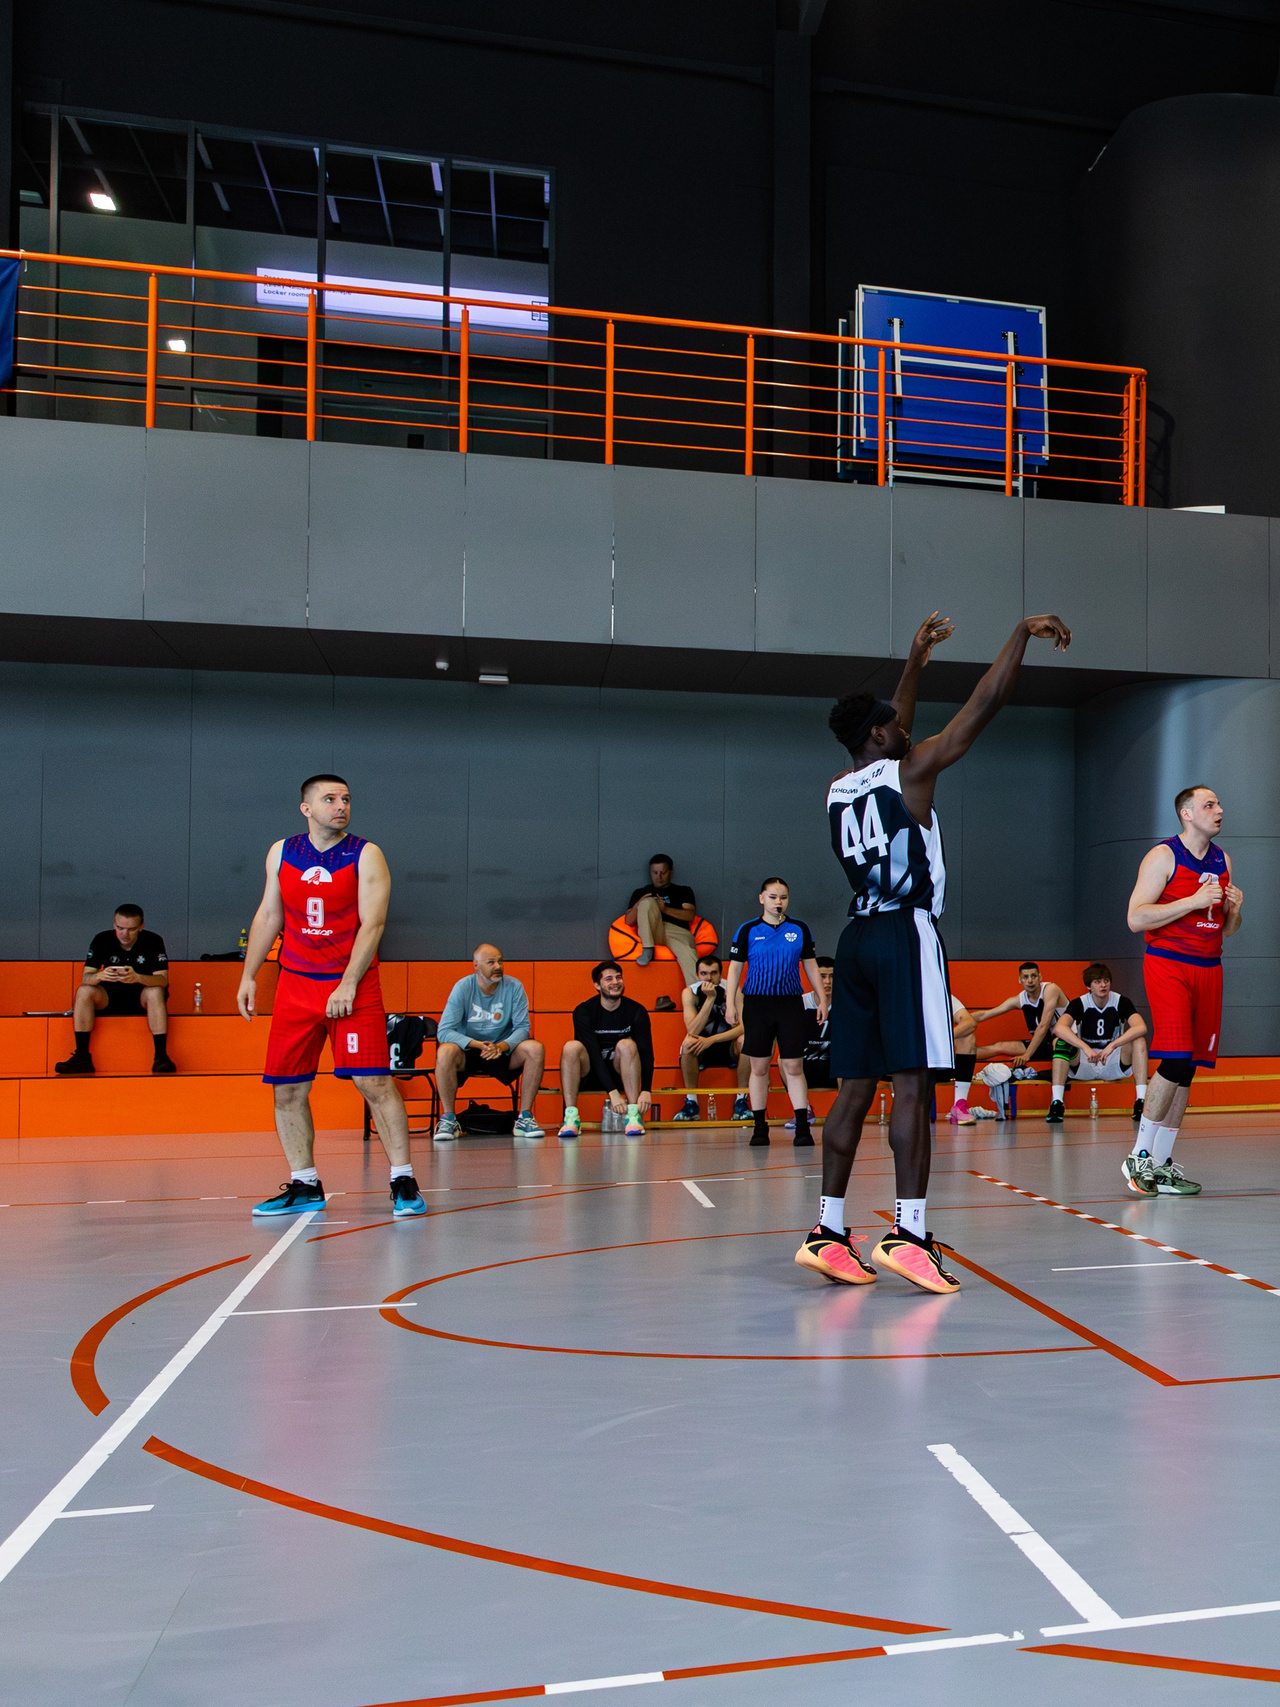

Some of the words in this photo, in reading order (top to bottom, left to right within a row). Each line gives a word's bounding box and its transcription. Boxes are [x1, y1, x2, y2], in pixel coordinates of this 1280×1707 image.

[841, 793, 889, 866] 44
[306, 896, 324, 928] 9
[1096, 1018, 1105, 1037] 8
[347, 1032, 359, 1054] 9
[1207, 1033, 1216, 1051] 1
